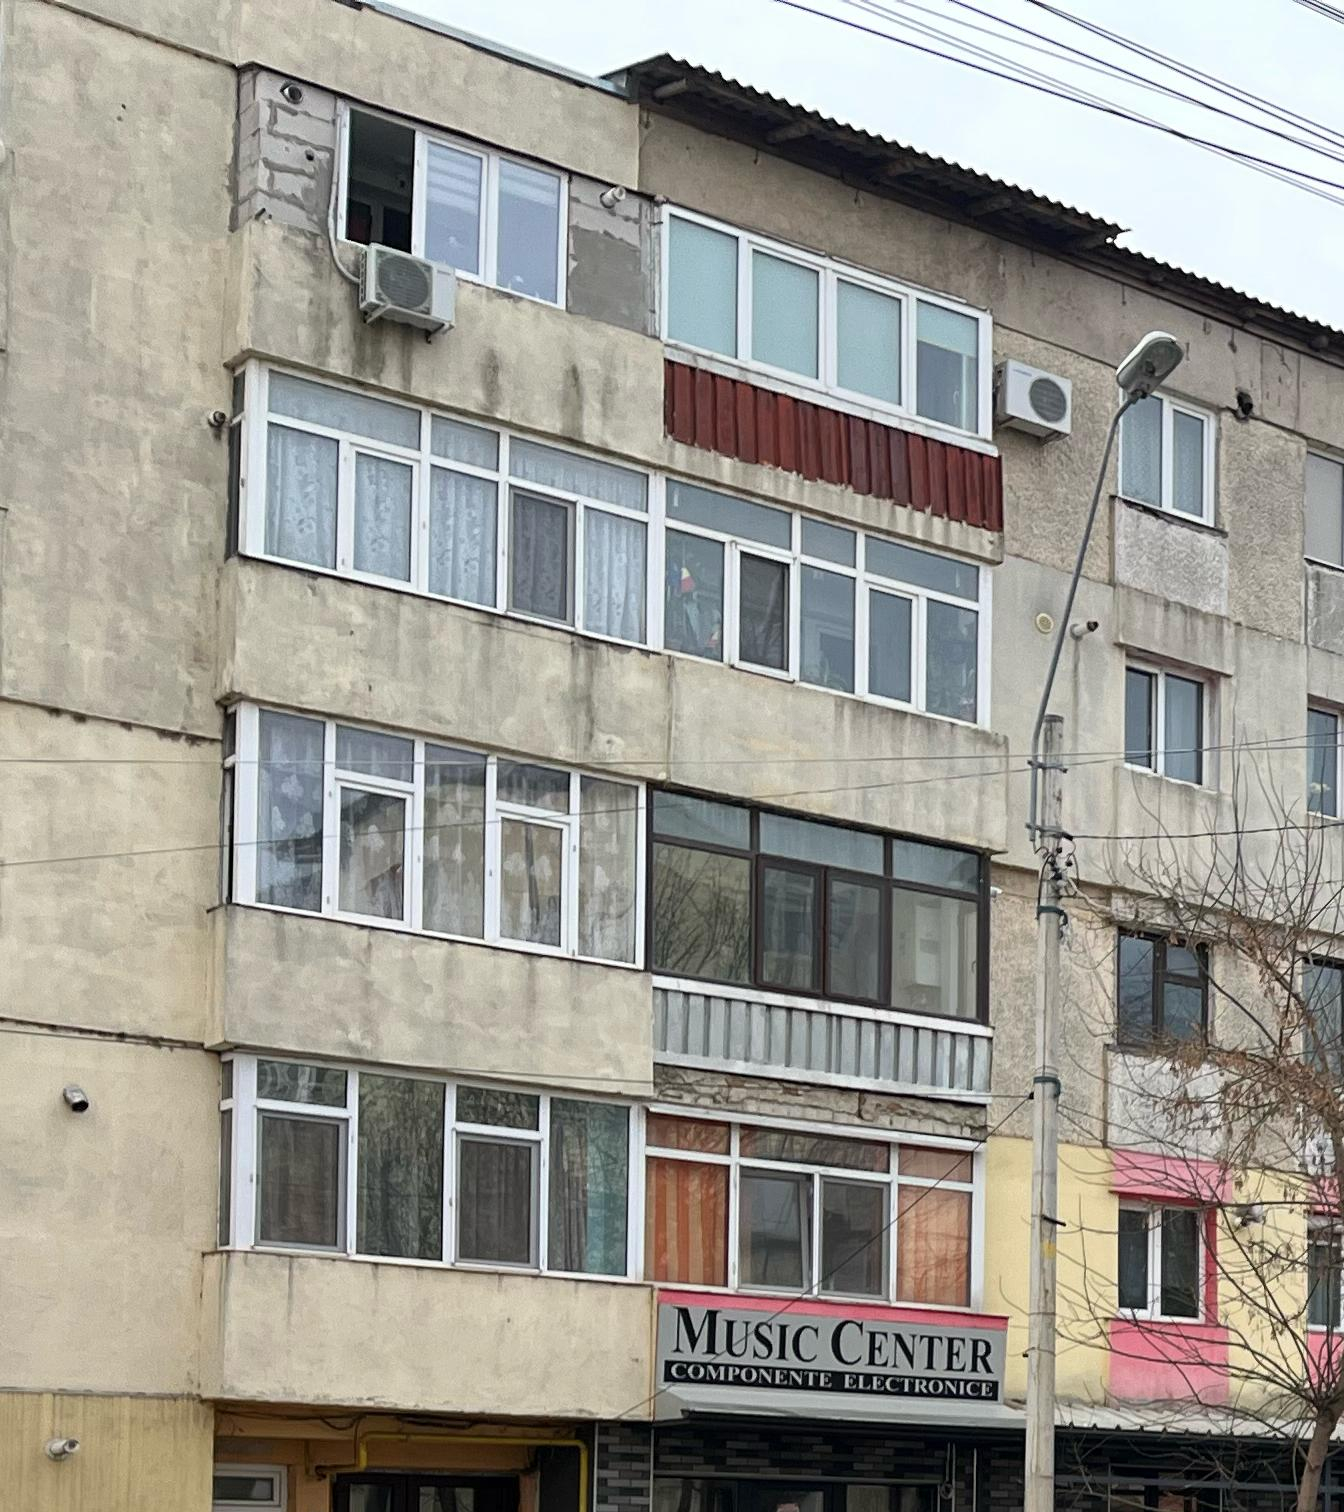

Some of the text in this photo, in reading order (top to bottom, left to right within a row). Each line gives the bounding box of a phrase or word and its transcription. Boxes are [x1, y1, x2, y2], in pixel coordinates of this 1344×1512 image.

[672, 1306, 994, 1374] MUSIC CENTER
[670, 1363, 993, 1397] COMPONENTE ELECTRONICE
